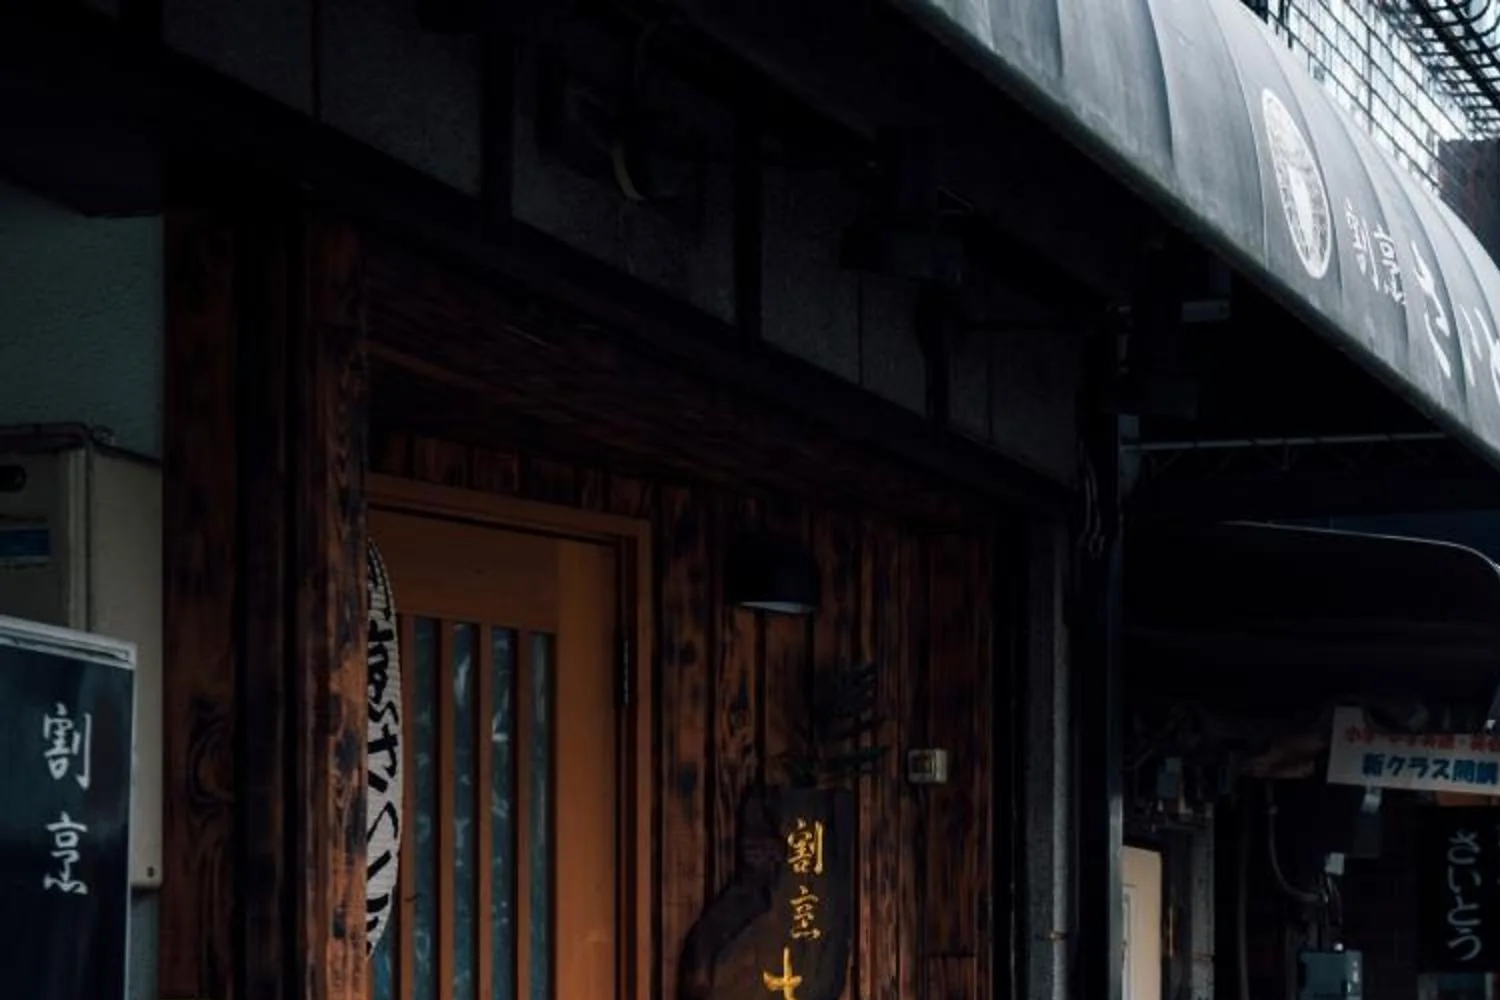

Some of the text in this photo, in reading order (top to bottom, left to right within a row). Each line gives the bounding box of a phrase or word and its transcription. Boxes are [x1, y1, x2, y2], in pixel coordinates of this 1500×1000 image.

[42, 700, 92, 895] 割烹
[1444, 826, 1484, 963] さいとう
